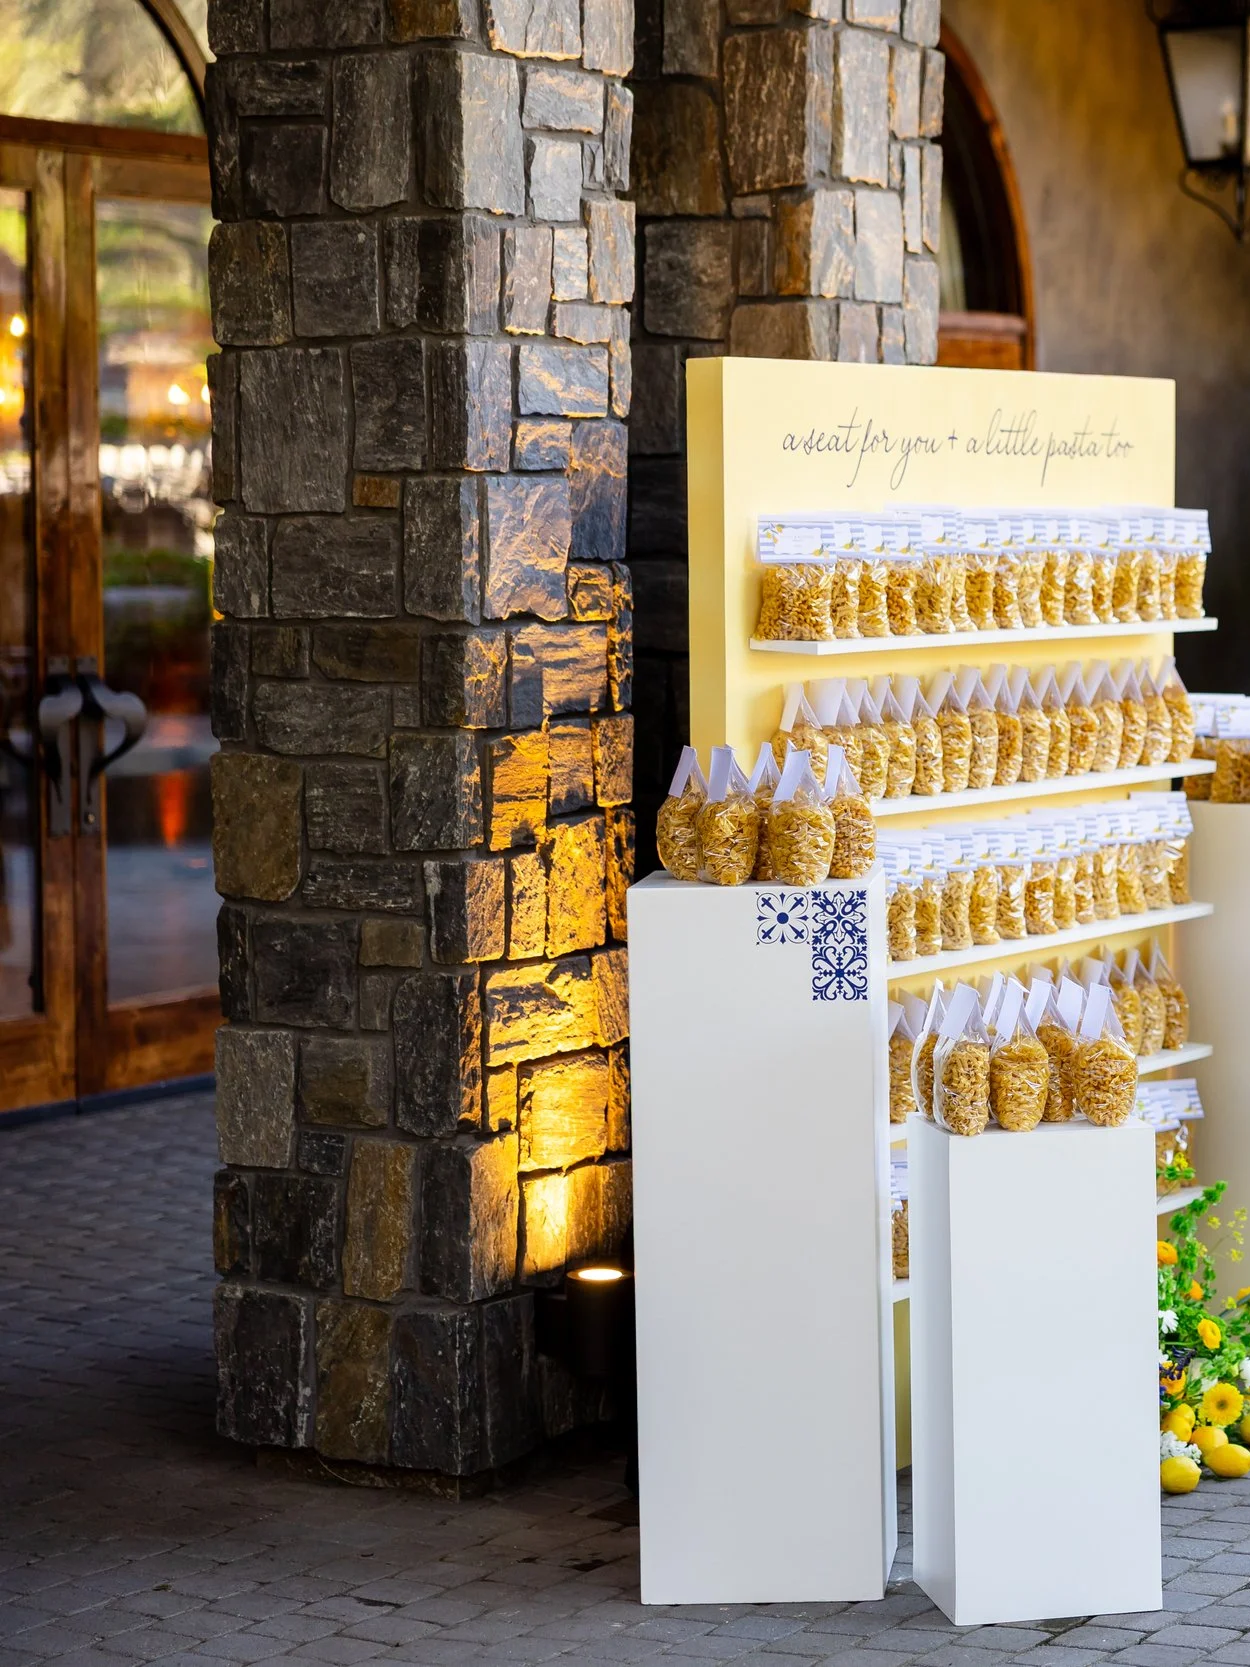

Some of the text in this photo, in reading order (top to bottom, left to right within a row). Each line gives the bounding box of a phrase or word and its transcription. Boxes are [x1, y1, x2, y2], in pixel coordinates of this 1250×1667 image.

[783, 406, 1135, 491] a seat for you + a little pasta too
